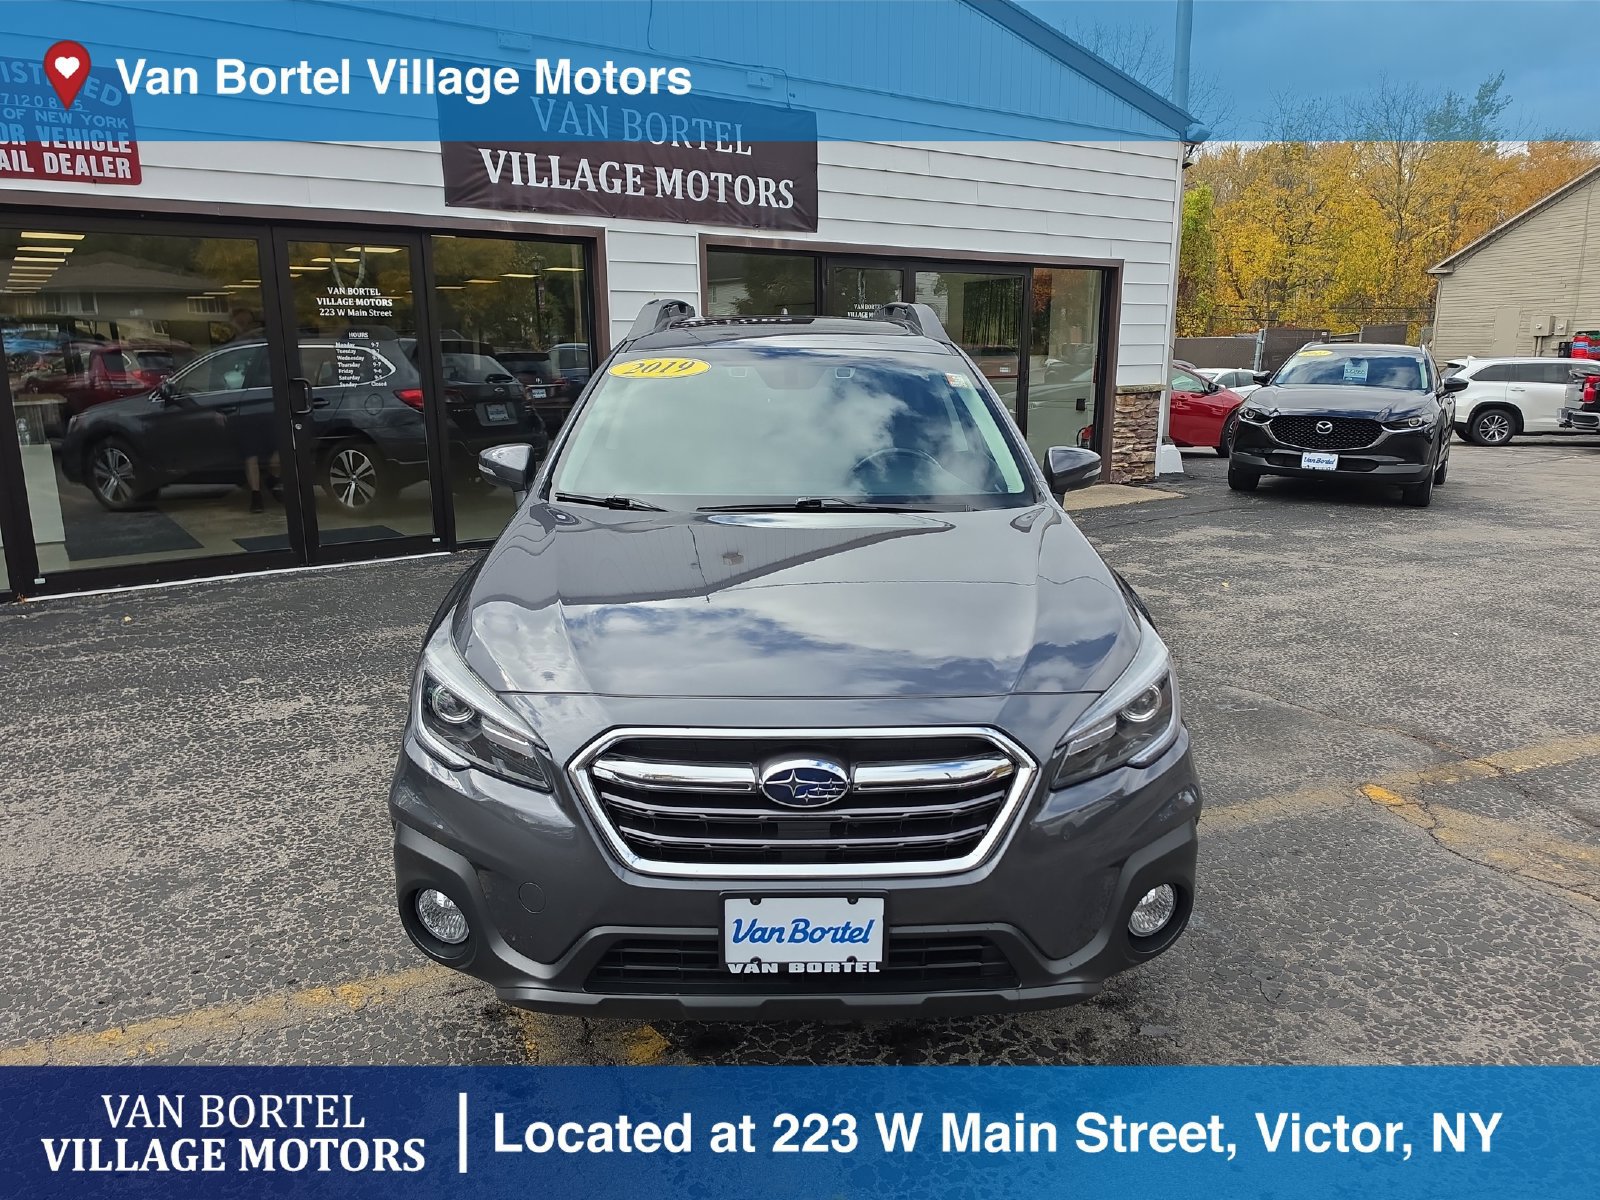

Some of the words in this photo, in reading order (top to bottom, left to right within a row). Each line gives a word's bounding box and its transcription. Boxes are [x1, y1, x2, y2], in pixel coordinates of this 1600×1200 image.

[2, 107, 26, 120] OF
[35, 109, 72, 124] NEW
[80, 114, 129, 129] YORK
[530, 96, 609, 139] VAN
[622, 107, 752, 156] BORTEL
[35, 125, 132, 154] VEHICLE
[42, 151, 132, 179] DEALER
[478, 147, 646, 197] VILLAGE
[655, 166, 794, 209] MOTORS
[327, 286, 345, 295] VAN
[347, 287, 380, 296] BORTEL
[316, 297, 354, 306] VILLAGE
[355, 298, 392, 307] MOTORS
[319, 308, 334, 316] 223
[347, 309, 367, 317] Main
[368, 309, 392, 317] Street
[622, 361, 695, 374] 2019
[727, 962, 779, 974] VAN
[788, 961, 881, 974] BORTEL
